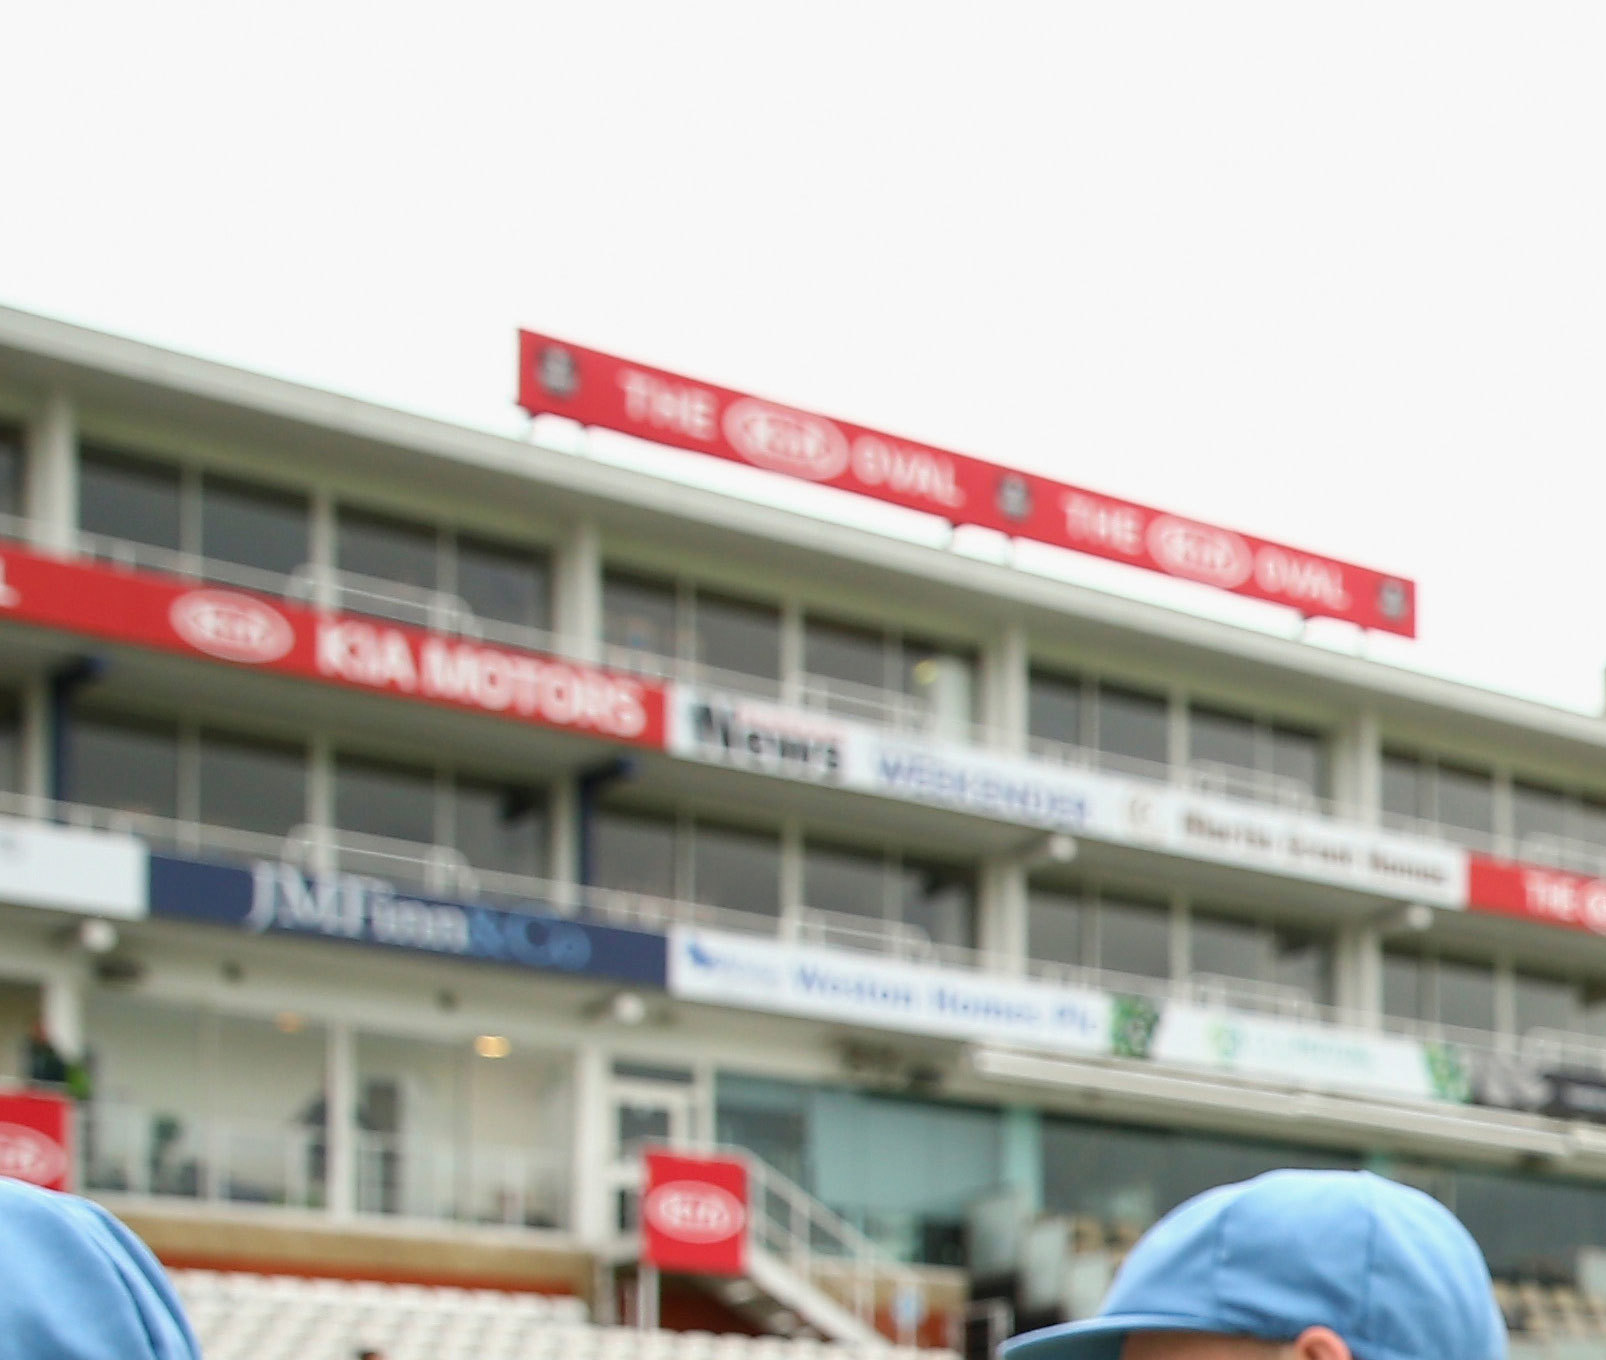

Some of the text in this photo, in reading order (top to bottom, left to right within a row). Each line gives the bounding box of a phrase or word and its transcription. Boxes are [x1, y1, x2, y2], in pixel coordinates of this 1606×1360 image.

[617, 370, 717, 441] THE
[852, 435, 965, 508] OVAL
[1061, 493, 1144, 556] THE
[316, 621, 645, 738] KIA MOTORS
